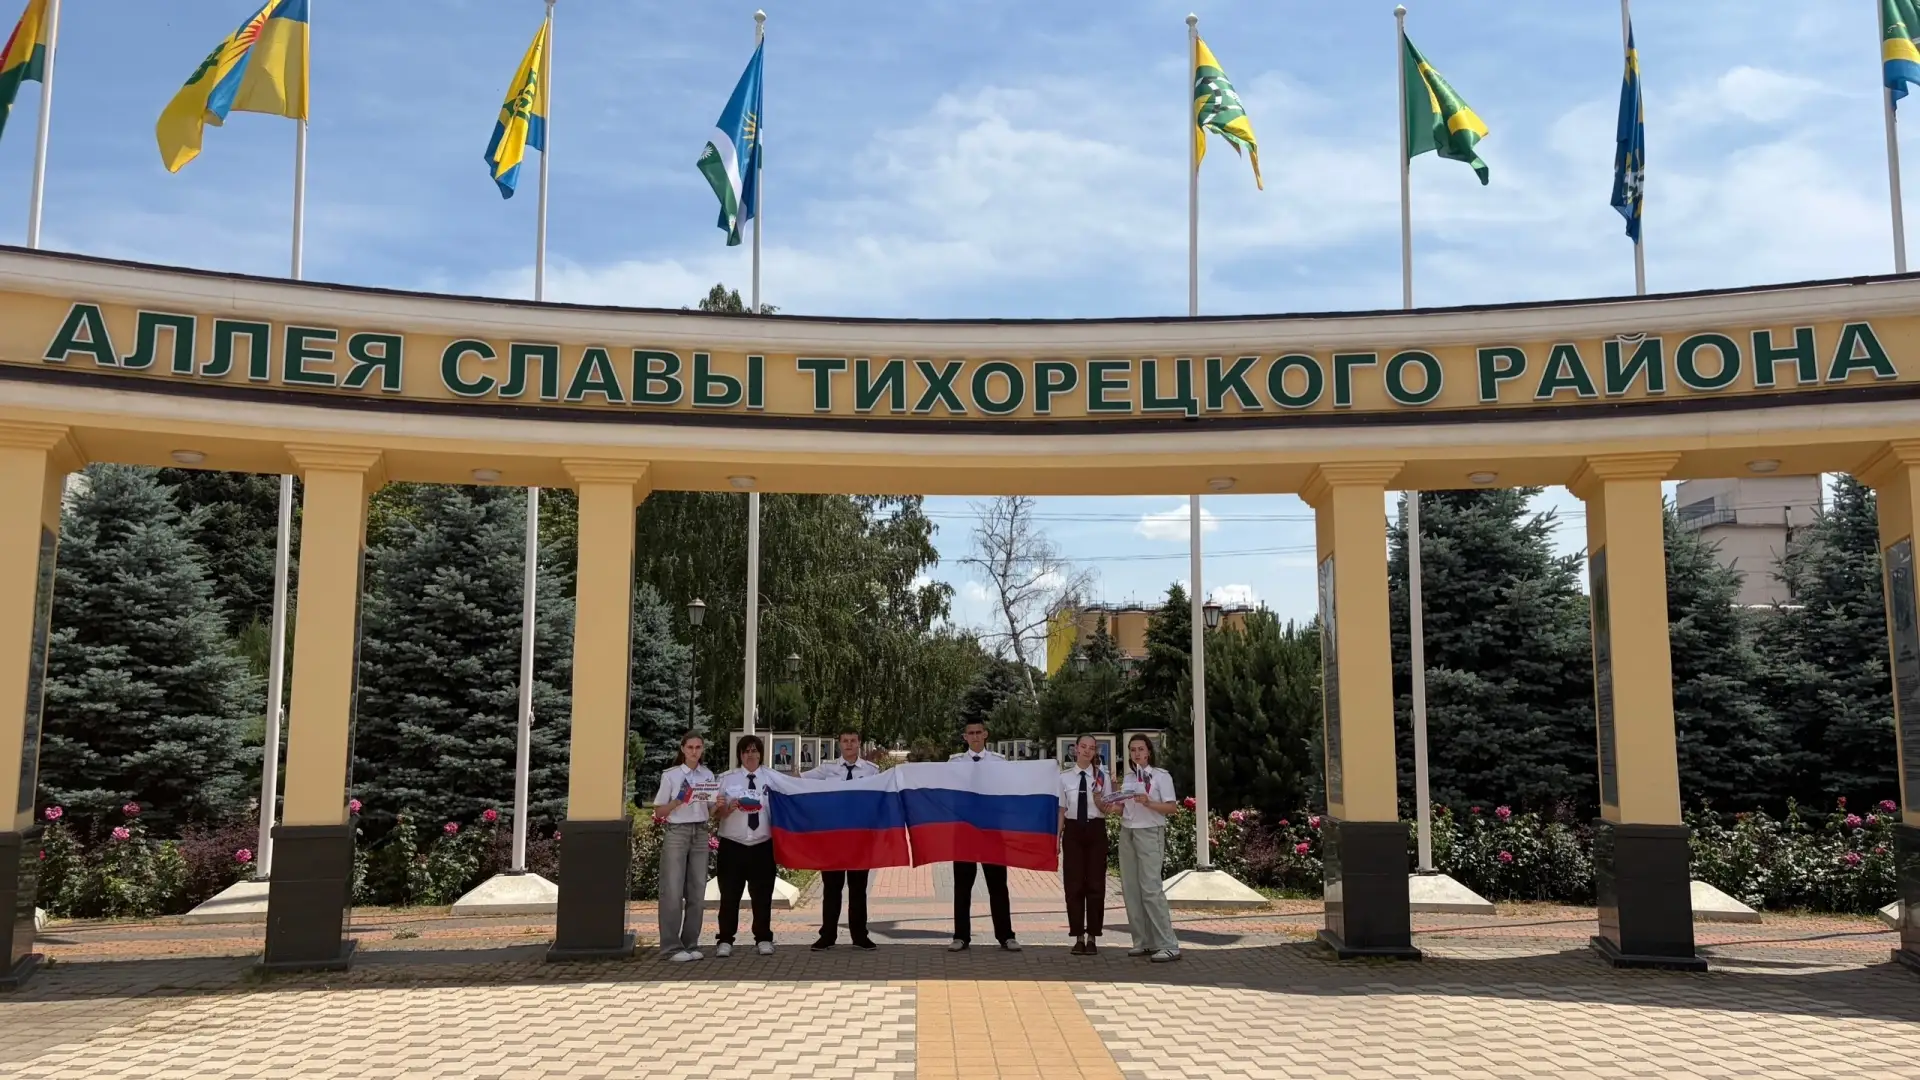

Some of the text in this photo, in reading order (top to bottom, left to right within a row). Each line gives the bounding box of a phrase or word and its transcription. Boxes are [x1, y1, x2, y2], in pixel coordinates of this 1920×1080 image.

[42, 302, 1899, 418] АЛЛЕЯ СЛАВЫ ТИХОРЕЦКОГО РАЙОНА
